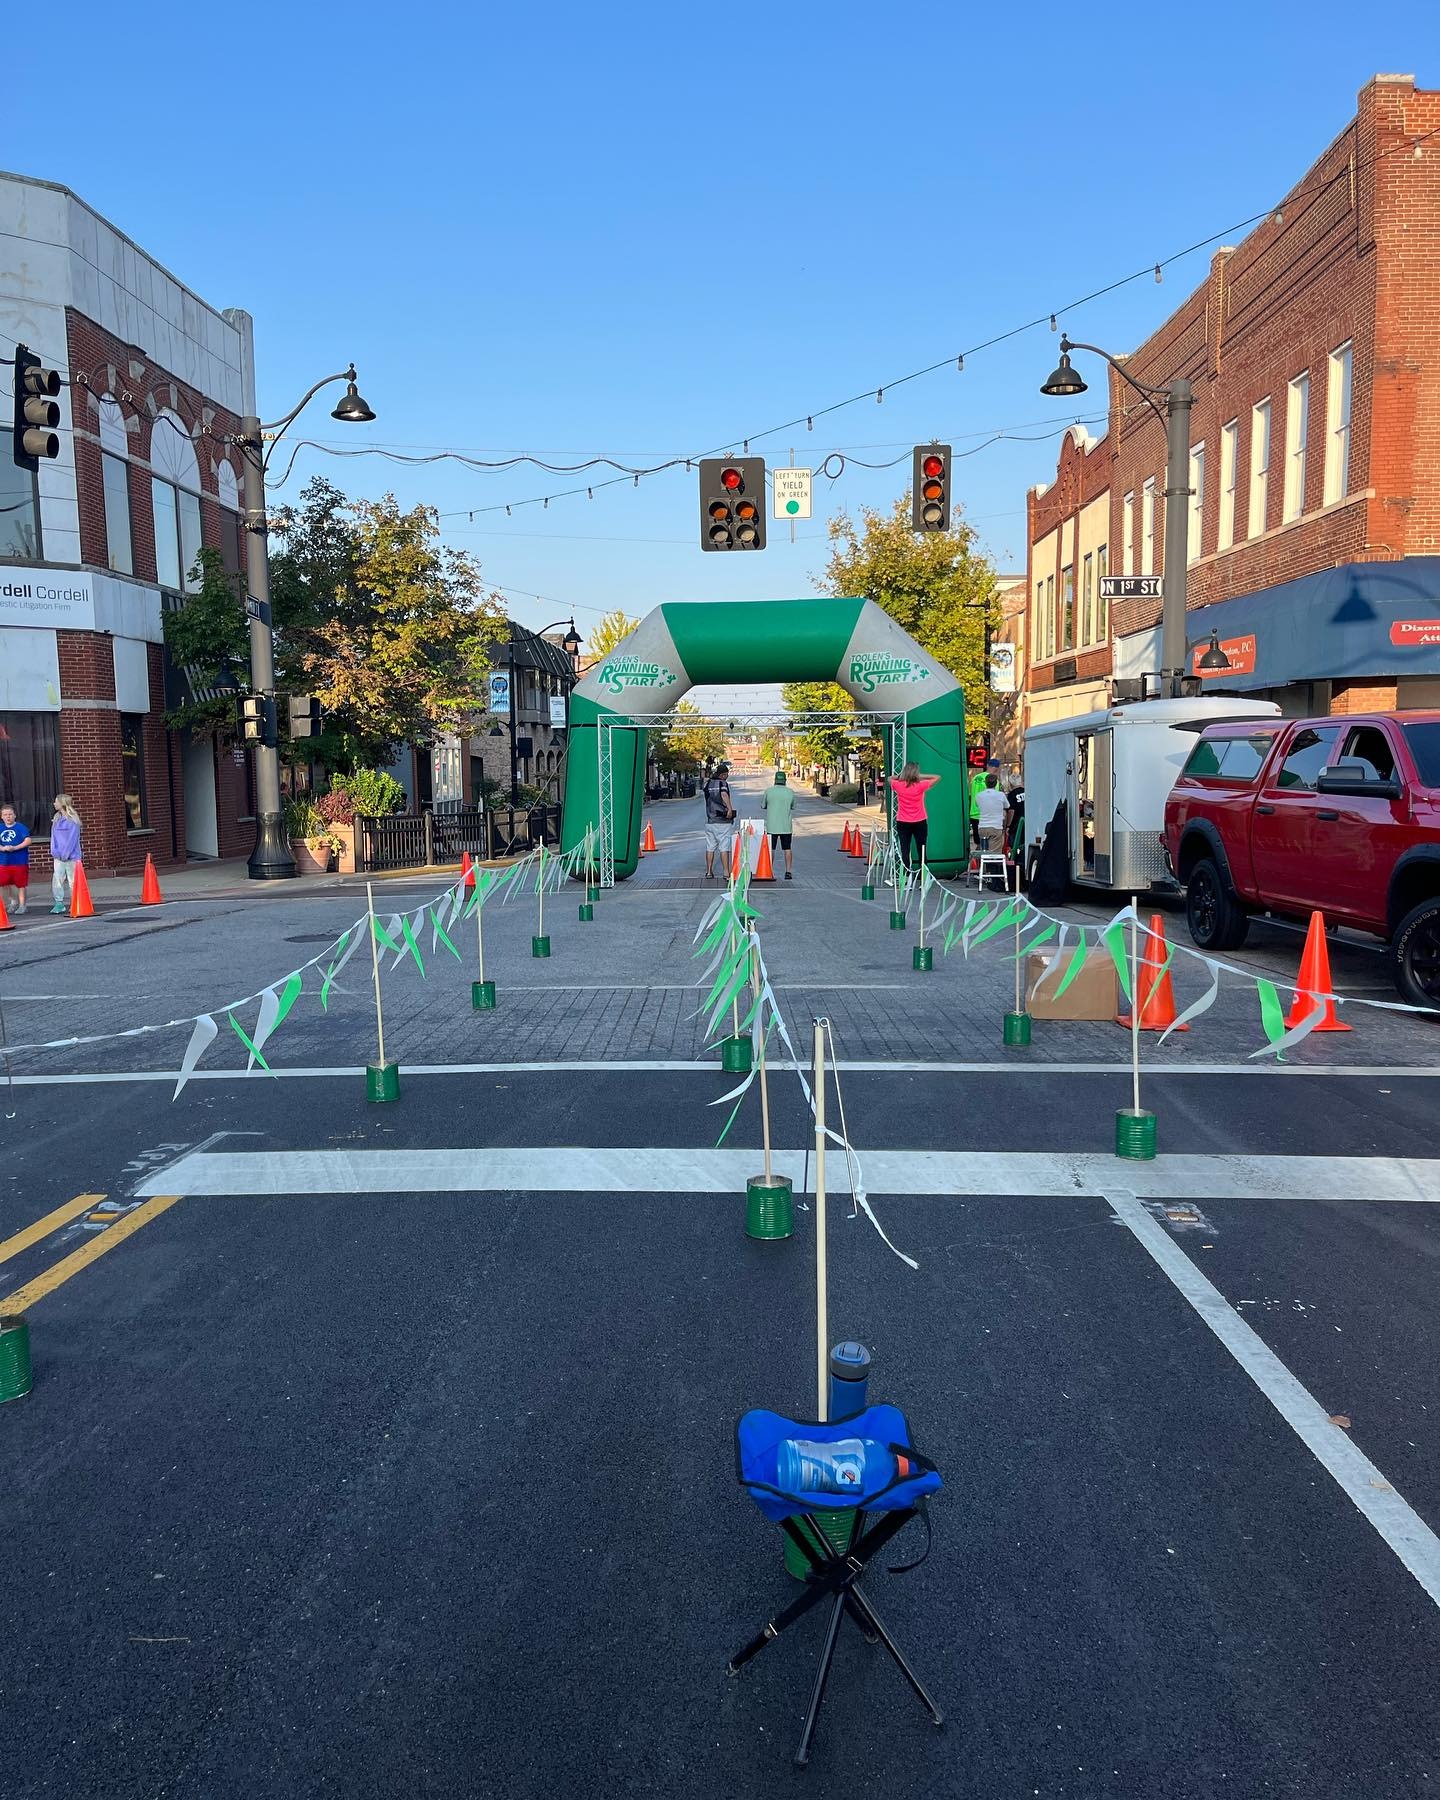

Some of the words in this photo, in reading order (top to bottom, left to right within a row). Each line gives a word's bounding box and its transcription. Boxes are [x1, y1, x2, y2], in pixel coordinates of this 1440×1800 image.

[782, 481, 803, 489] YIELD
[0, 583, 32, 598] dell
[36, 585, 89, 602] Cordell
[1105, 580, 1115, 595] N
[1120, 580, 1135, 595] 1ST
[1140, 580, 1157, 594] ST
[20, 601, 53, 611] Litigation
[54, 603, 71, 611] Firm
[1400, 624, 1440, 632] Dixon
[851, 652, 891, 662] TOOLEN'S
[1232, 659, 1245, 669] Law
[598, 663, 659, 684] RUNNING
[850, 659, 911, 683] RUNNING
[609, 672, 659, 693] START
[863, 669, 911, 692] START
